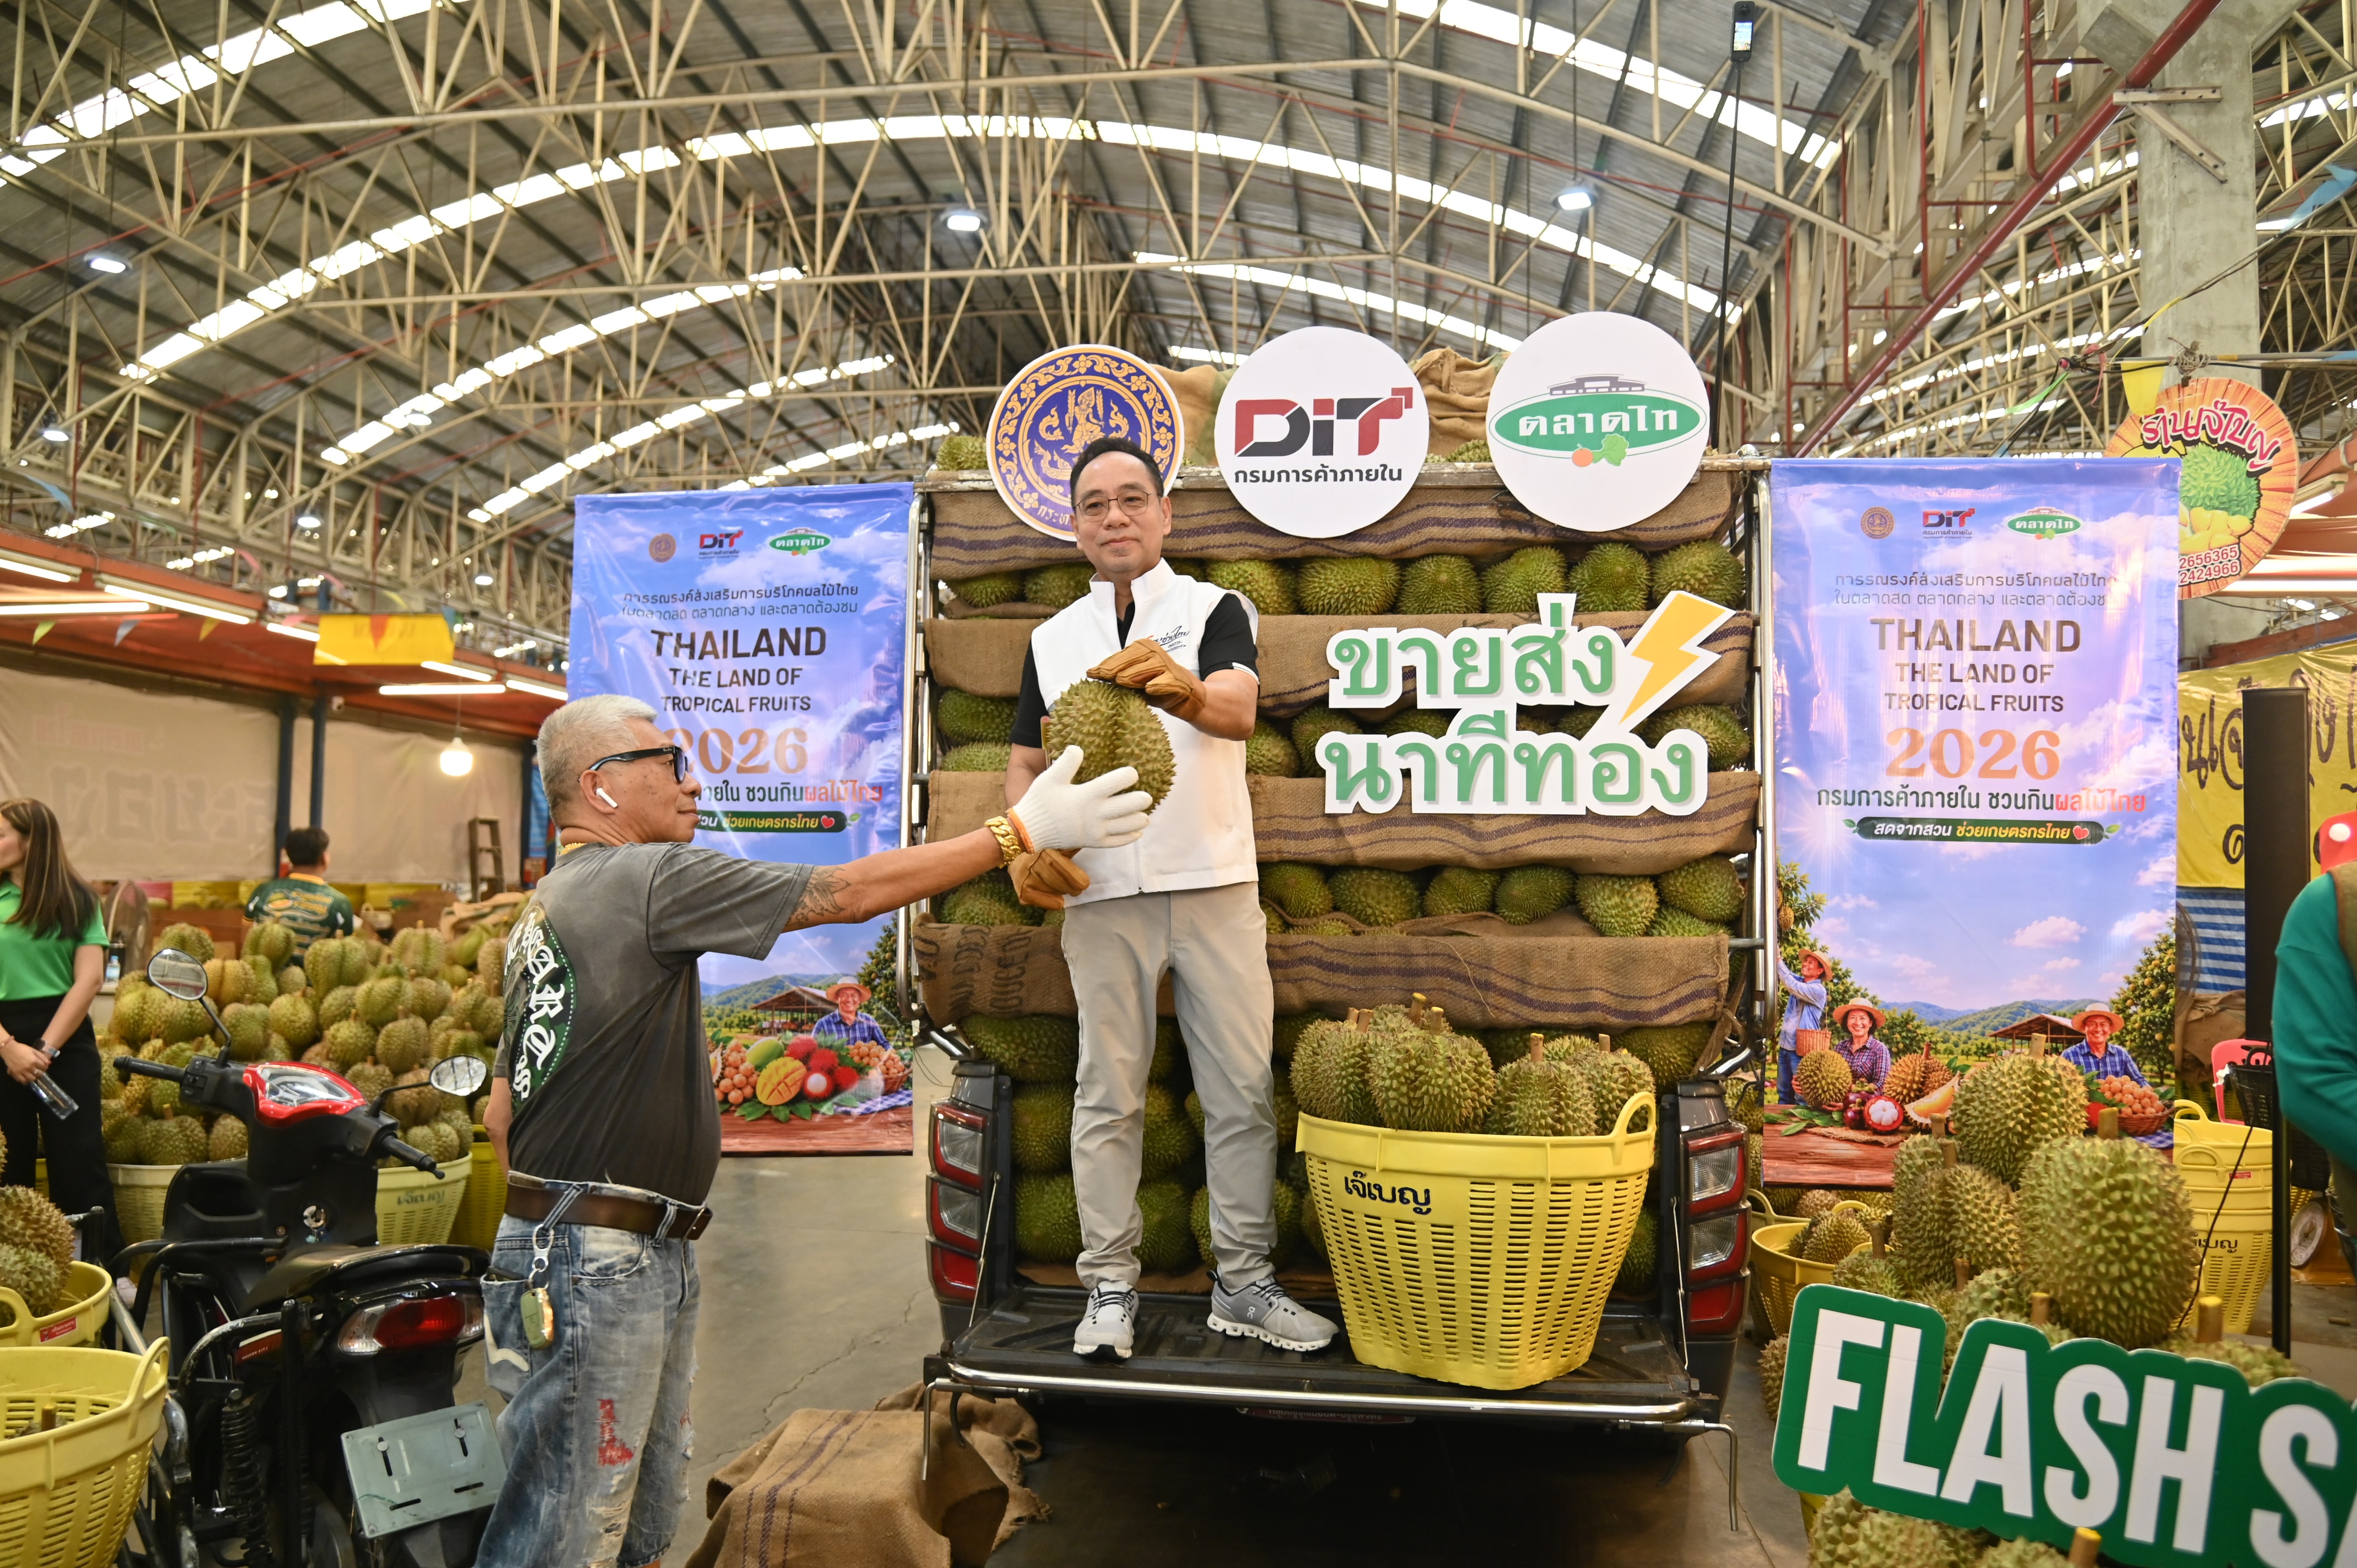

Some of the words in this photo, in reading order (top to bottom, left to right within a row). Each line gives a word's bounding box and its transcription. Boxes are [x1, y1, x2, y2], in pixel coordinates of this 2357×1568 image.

[1519, 405, 1677, 436] ตลาดไท
[1235, 464, 1402, 483] กรมการค้าภายใน
[2179, 561, 2238, 584] 2424966
[1834, 589, 1910, 605] ในตลาดสด
[1917, 591, 1995, 606] ตลาดกลาง
[692, 604, 755, 619] ตลาดกลาง
[760, 600, 858, 616] และตลาดต้องชม
[650, 626, 826, 661] THAILAND
[1870, 618, 2081, 652] THAILAND
[1334, 603, 1613, 696] ขายส่ง
[669, 668, 712, 687] THE
[717, 669, 770, 688] LAND
[776, 668, 803, 685] OF
[1895, 663, 1943, 683] THE
[1950, 663, 2016, 684] LAND
[2023, 663, 2054, 684] OF
[661, 696, 745, 713] TROPICAL
[749, 695, 811, 712] FRUITS
[1884, 693, 1985, 712] TROPICAL
[1991, 694, 2064, 712] FRUITS
[1325, 710, 1691, 803] นาทีทอง
[1885, 727, 2060, 780] 2026
[698, 780, 740, 802] ายใน
[1817, 784, 1979, 808] กรมการค้าภายใน
[723, 813, 818, 829] ช่วยเกษตรกรไทย
[1874, 822, 1951, 837] สดจากสวน
[1956, 821, 2070, 839] ช่วยเกษตรกรไทย
[1344, 1170, 1432, 1215] เจ๊เบญ
[1798, 1309, 2224, 1553] FLASH
[2249, 1404, 2357, 1568] S
